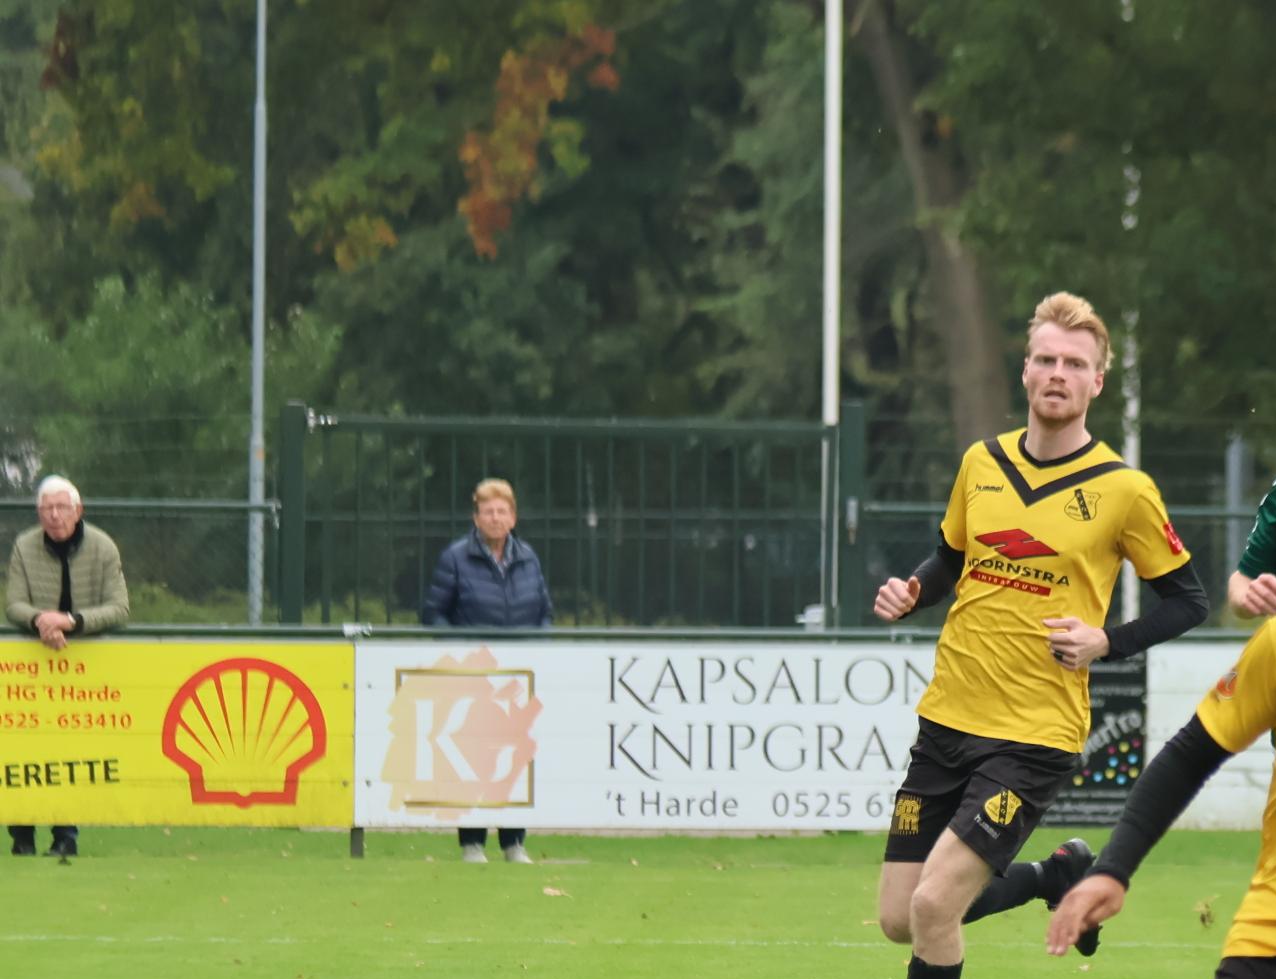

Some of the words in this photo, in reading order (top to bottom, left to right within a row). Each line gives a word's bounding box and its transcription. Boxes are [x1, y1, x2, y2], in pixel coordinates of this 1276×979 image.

[48, 658, 69, 675] 10
[75, 662, 86, 675] a
[7, 685, 37, 701] HG
[60, 685, 121, 702] Harde
[608, 656, 929, 714] KAPSALON
[0, 713, 39, 729] 525
[57, 712, 132, 729] 653410
[608, 723, 912, 781] KNIPGRA
[0, 759, 120, 788] ERETTE
[640, 790, 740, 818] Harde
[772, 792, 851, 818] 0525
